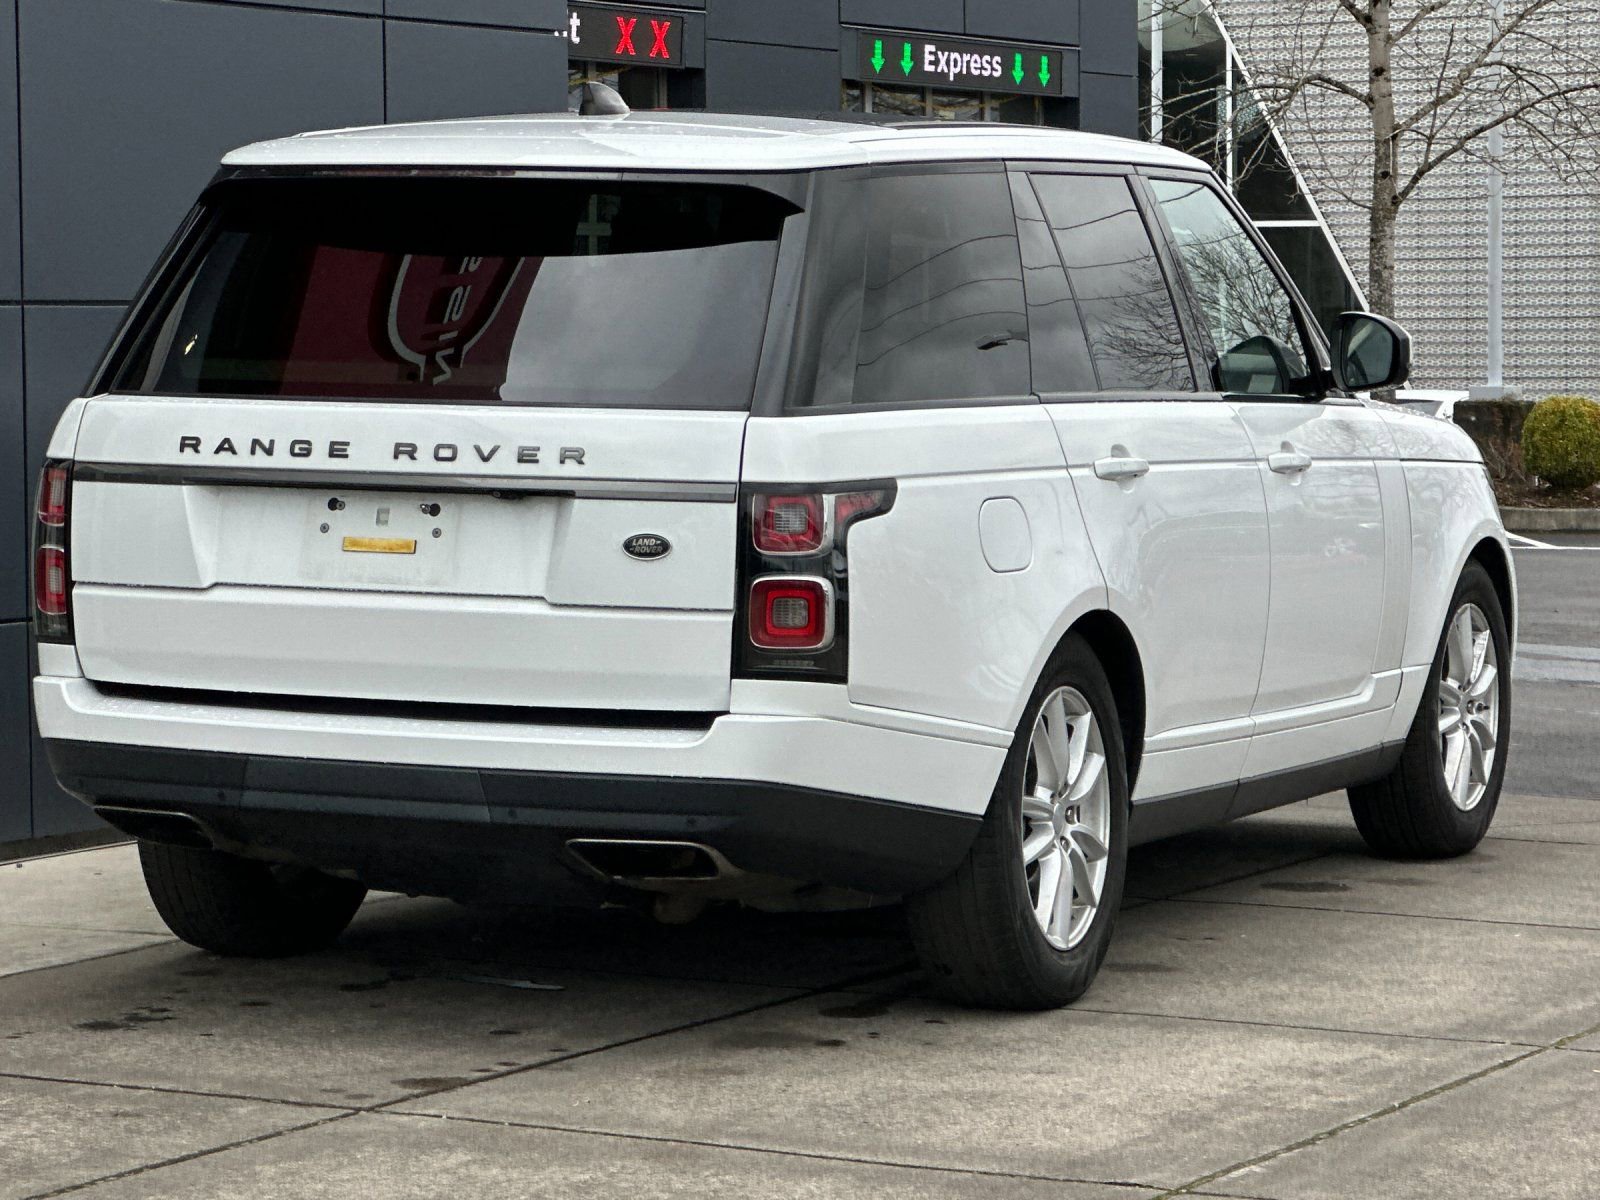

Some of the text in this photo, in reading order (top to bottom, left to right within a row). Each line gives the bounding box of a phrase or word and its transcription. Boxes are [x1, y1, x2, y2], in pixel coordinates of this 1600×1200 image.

[923, 44, 1002, 81] Express
[179, 435, 586, 466] RANGE ROVER
